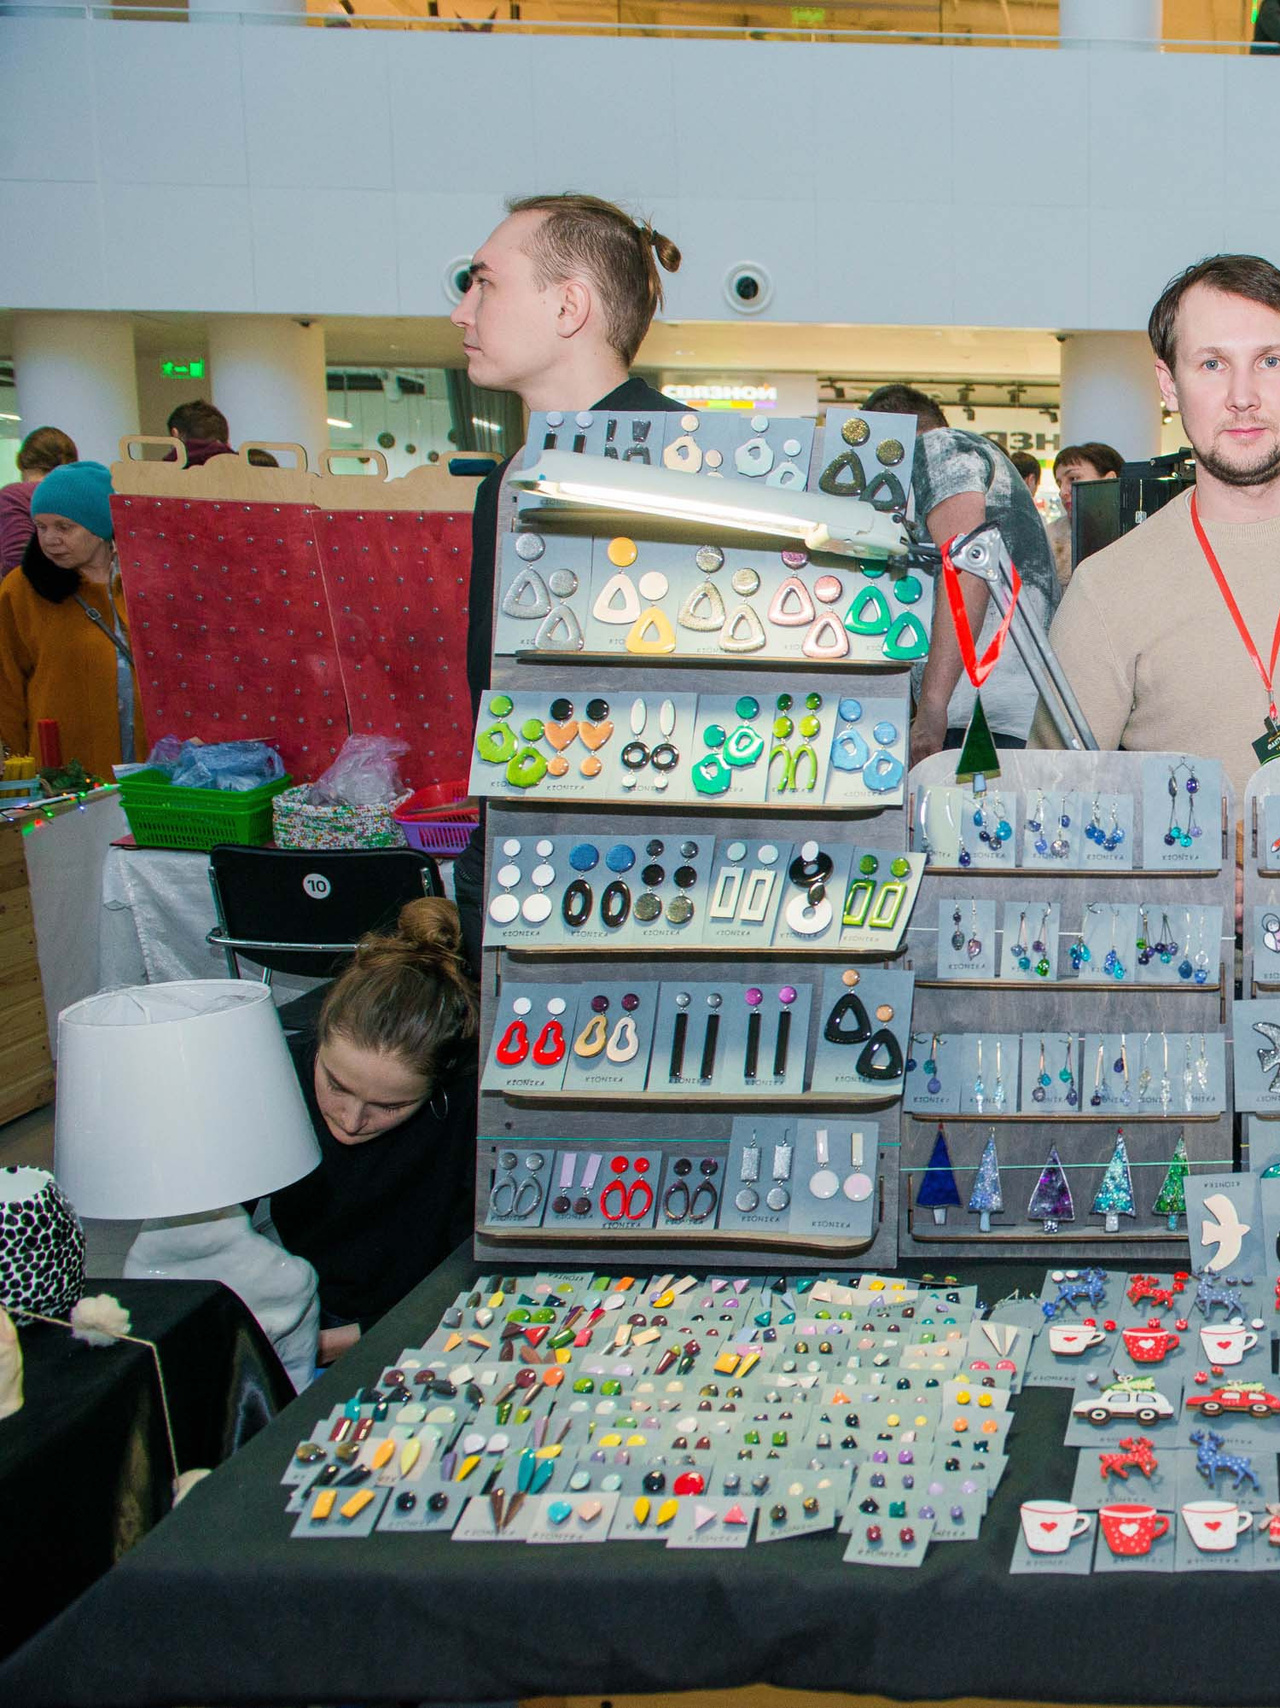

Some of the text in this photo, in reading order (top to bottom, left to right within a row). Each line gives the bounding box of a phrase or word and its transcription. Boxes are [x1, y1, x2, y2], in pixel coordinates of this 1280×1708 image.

[1162, 854, 1200, 862] KIONIKA
[307, 879, 327, 893] 10
[502, 930, 541, 938] KIONIKA
[570, 930, 609, 938] KIONIKA
[948, 963, 987, 971] KIONIKA
[505, 1078, 546, 1087] KIONIKA
[585, 1076, 624, 1084] KIONIKA
[741, 1215, 781, 1223] KIONIKA
[601, 1221, 642, 1230] KIONIKA
[811, 1221, 851, 1229] KIONIKA
